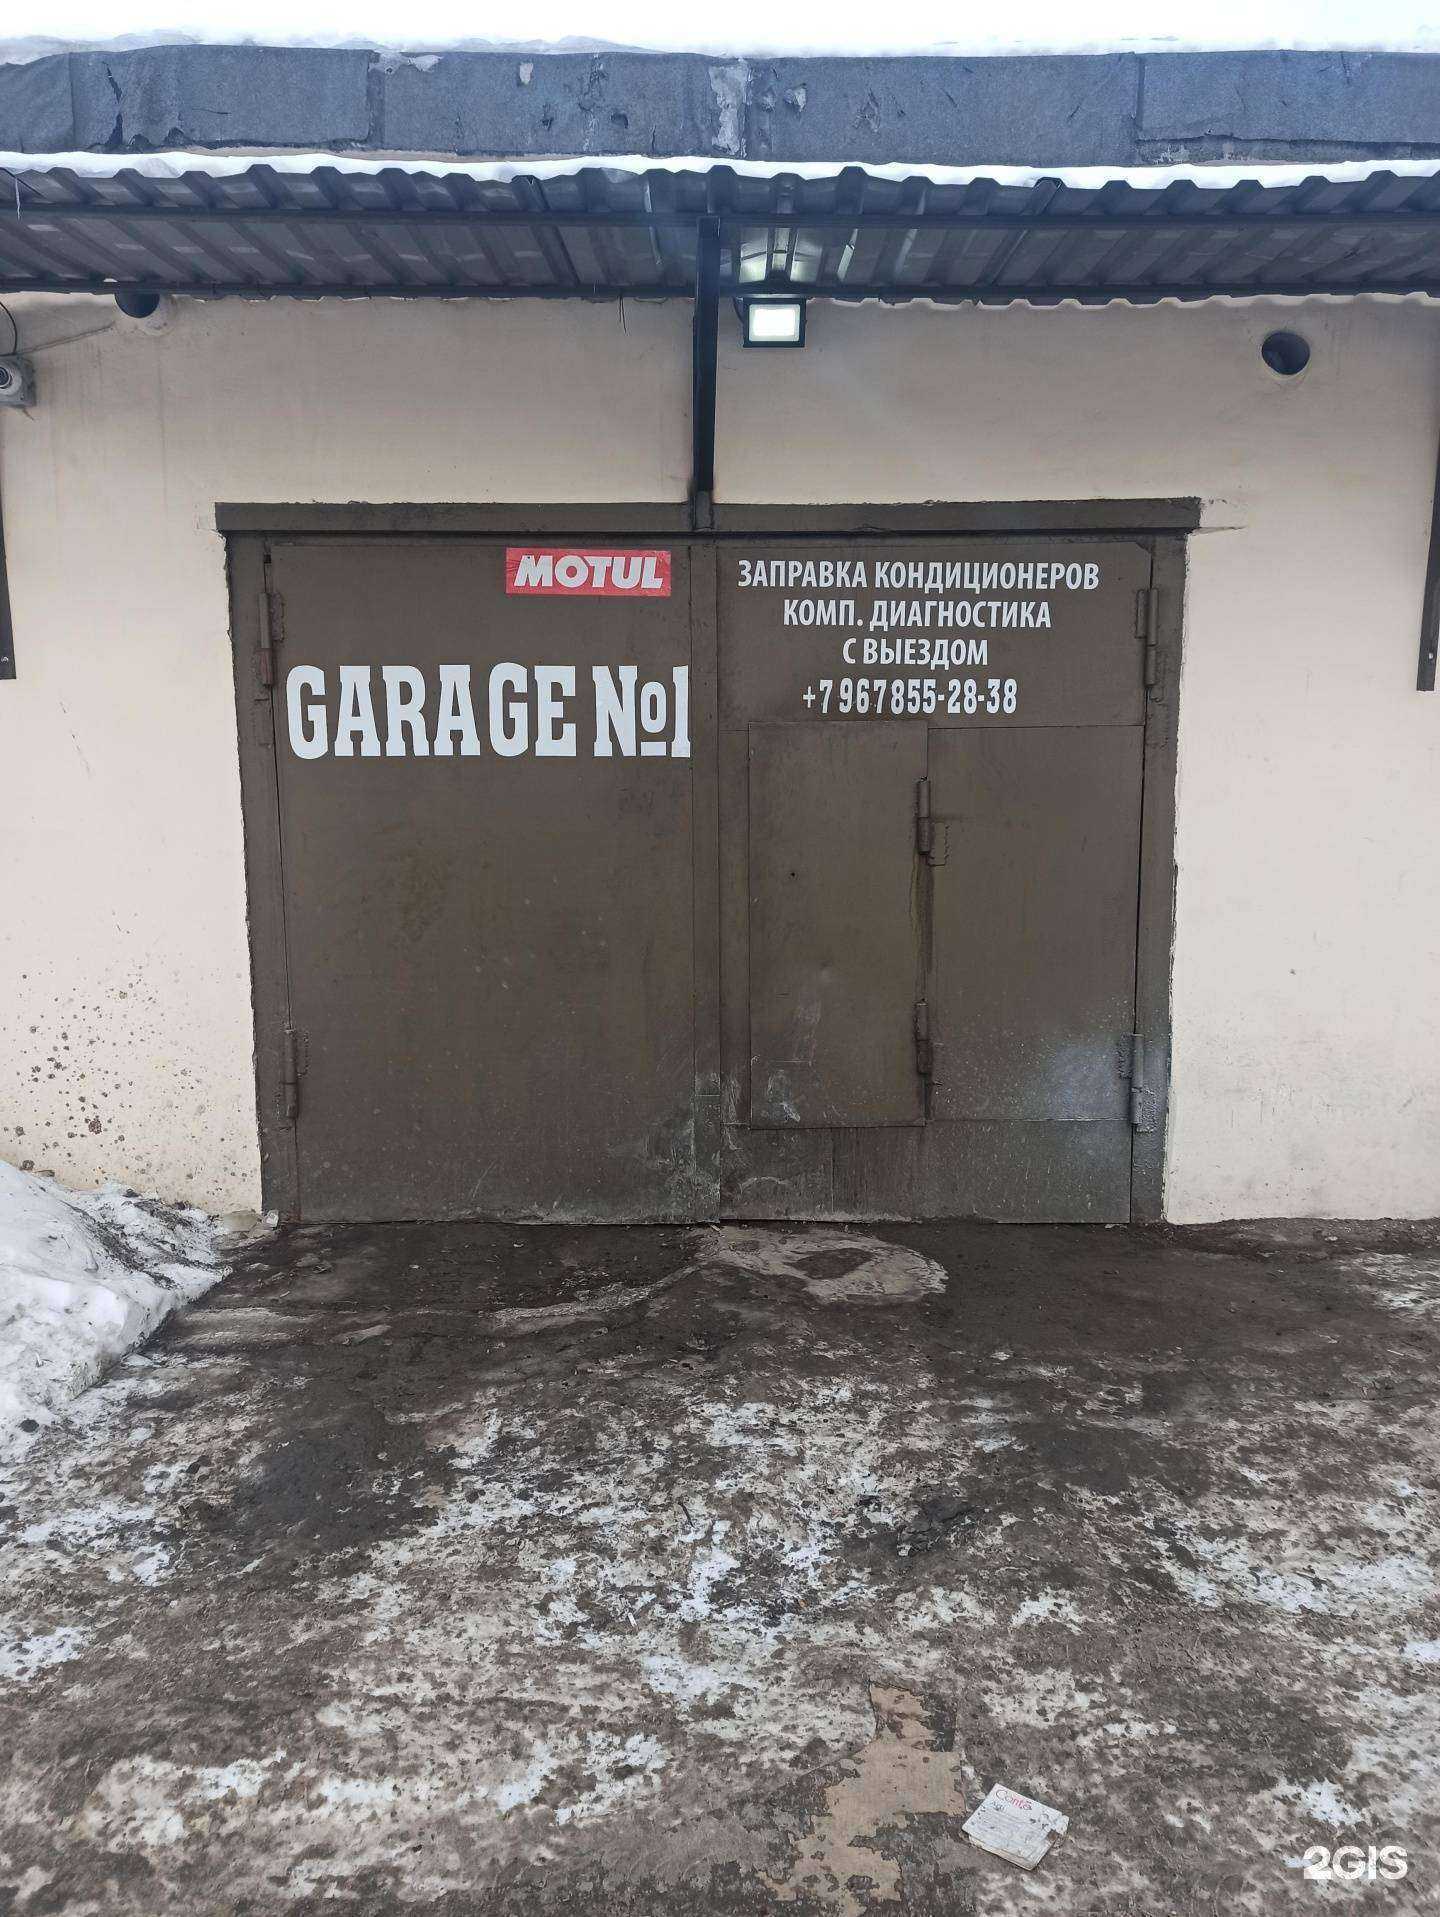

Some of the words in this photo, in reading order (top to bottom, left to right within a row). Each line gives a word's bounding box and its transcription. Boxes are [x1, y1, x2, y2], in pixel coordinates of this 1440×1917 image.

[514, 555, 664, 589] MOTUL
[737, 559, 868, 588] ЗАПРАВКА
[874, 561, 1100, 594] КОНДИЦИОНЕРОВ
[783, 598, 864, 627] КОМП.
[869, 600, 1051, 632] ДИАГНОСТИКА
[842, 637, 857, 664] С
[862, 638, 988, 670] ВЫЕЗДОМ
[285, 662, 577, 760] GARAGE
